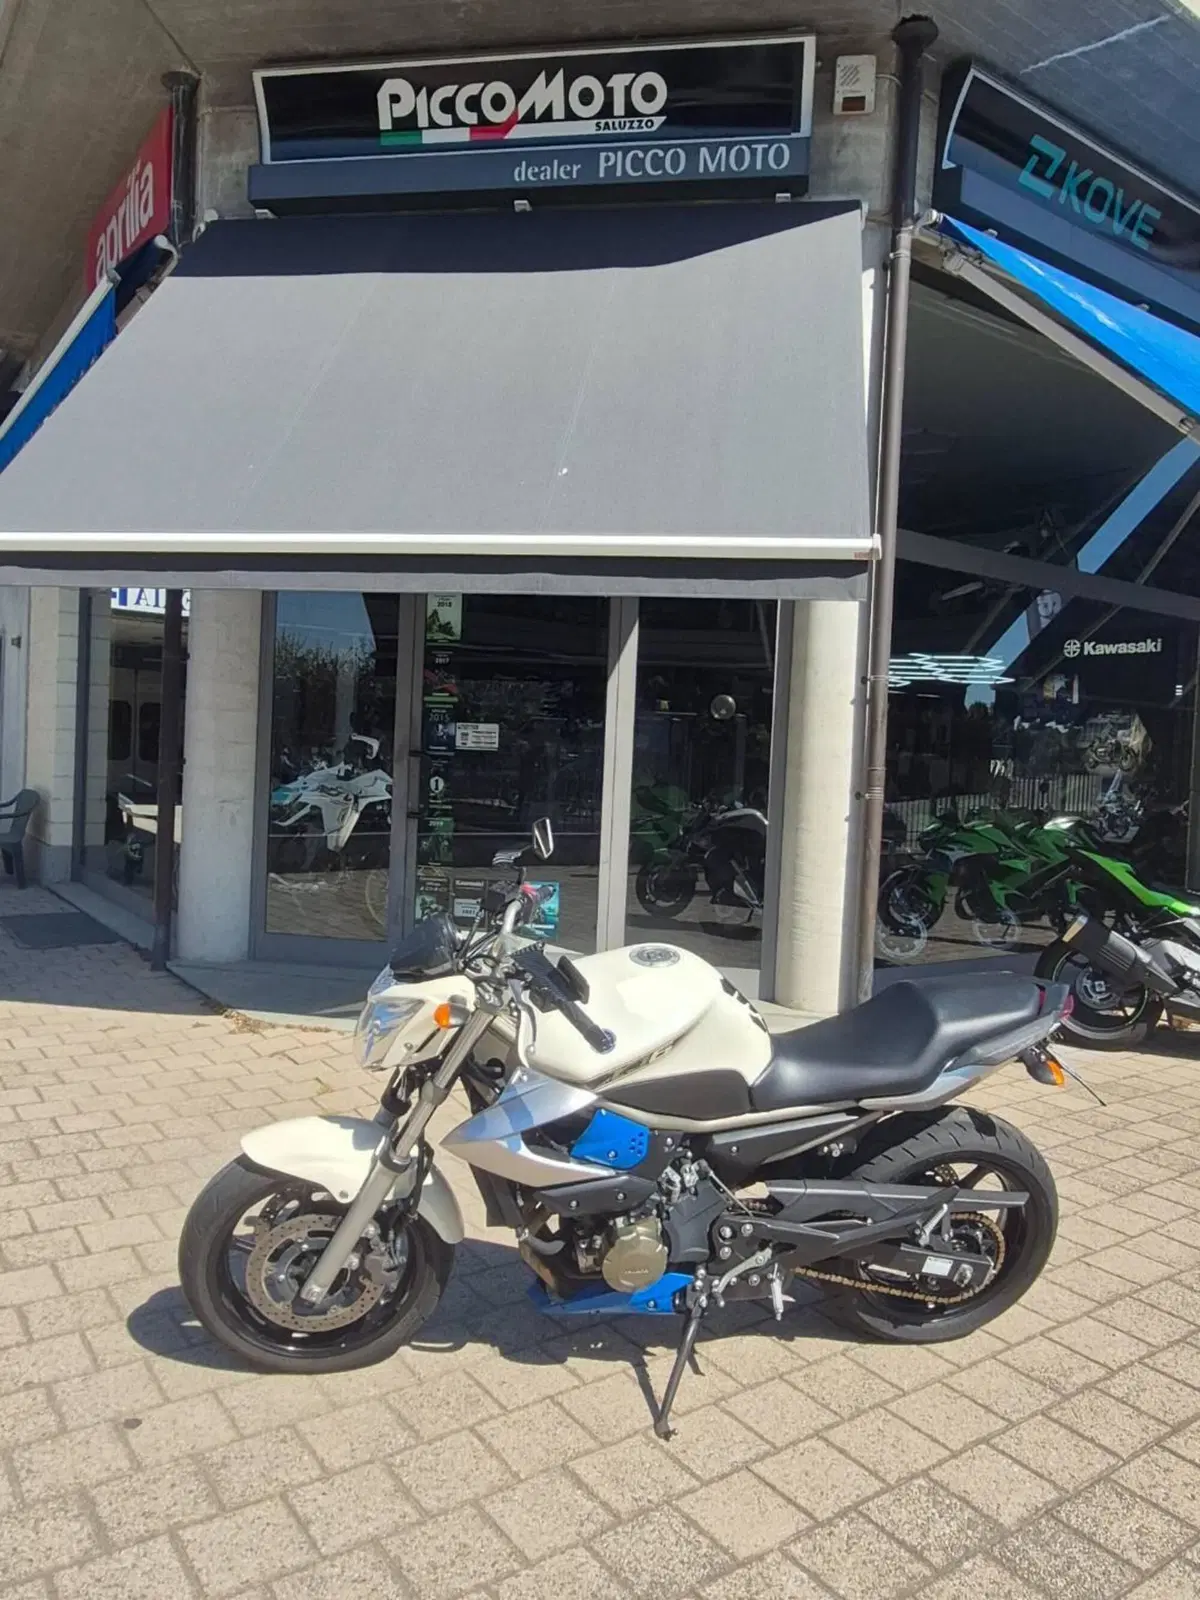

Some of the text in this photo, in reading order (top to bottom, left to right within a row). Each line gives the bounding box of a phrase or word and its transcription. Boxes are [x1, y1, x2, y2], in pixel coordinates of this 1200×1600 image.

[595, 118, 654, 131] SALUZZO
[513, 143, 790, 182] dealer PICCO MOTO
[96, 159, 153, 286] aprilia
[1059, 160, 1162, 250] KOVE
[1083, 638, 1163, 655] Kawasaki
